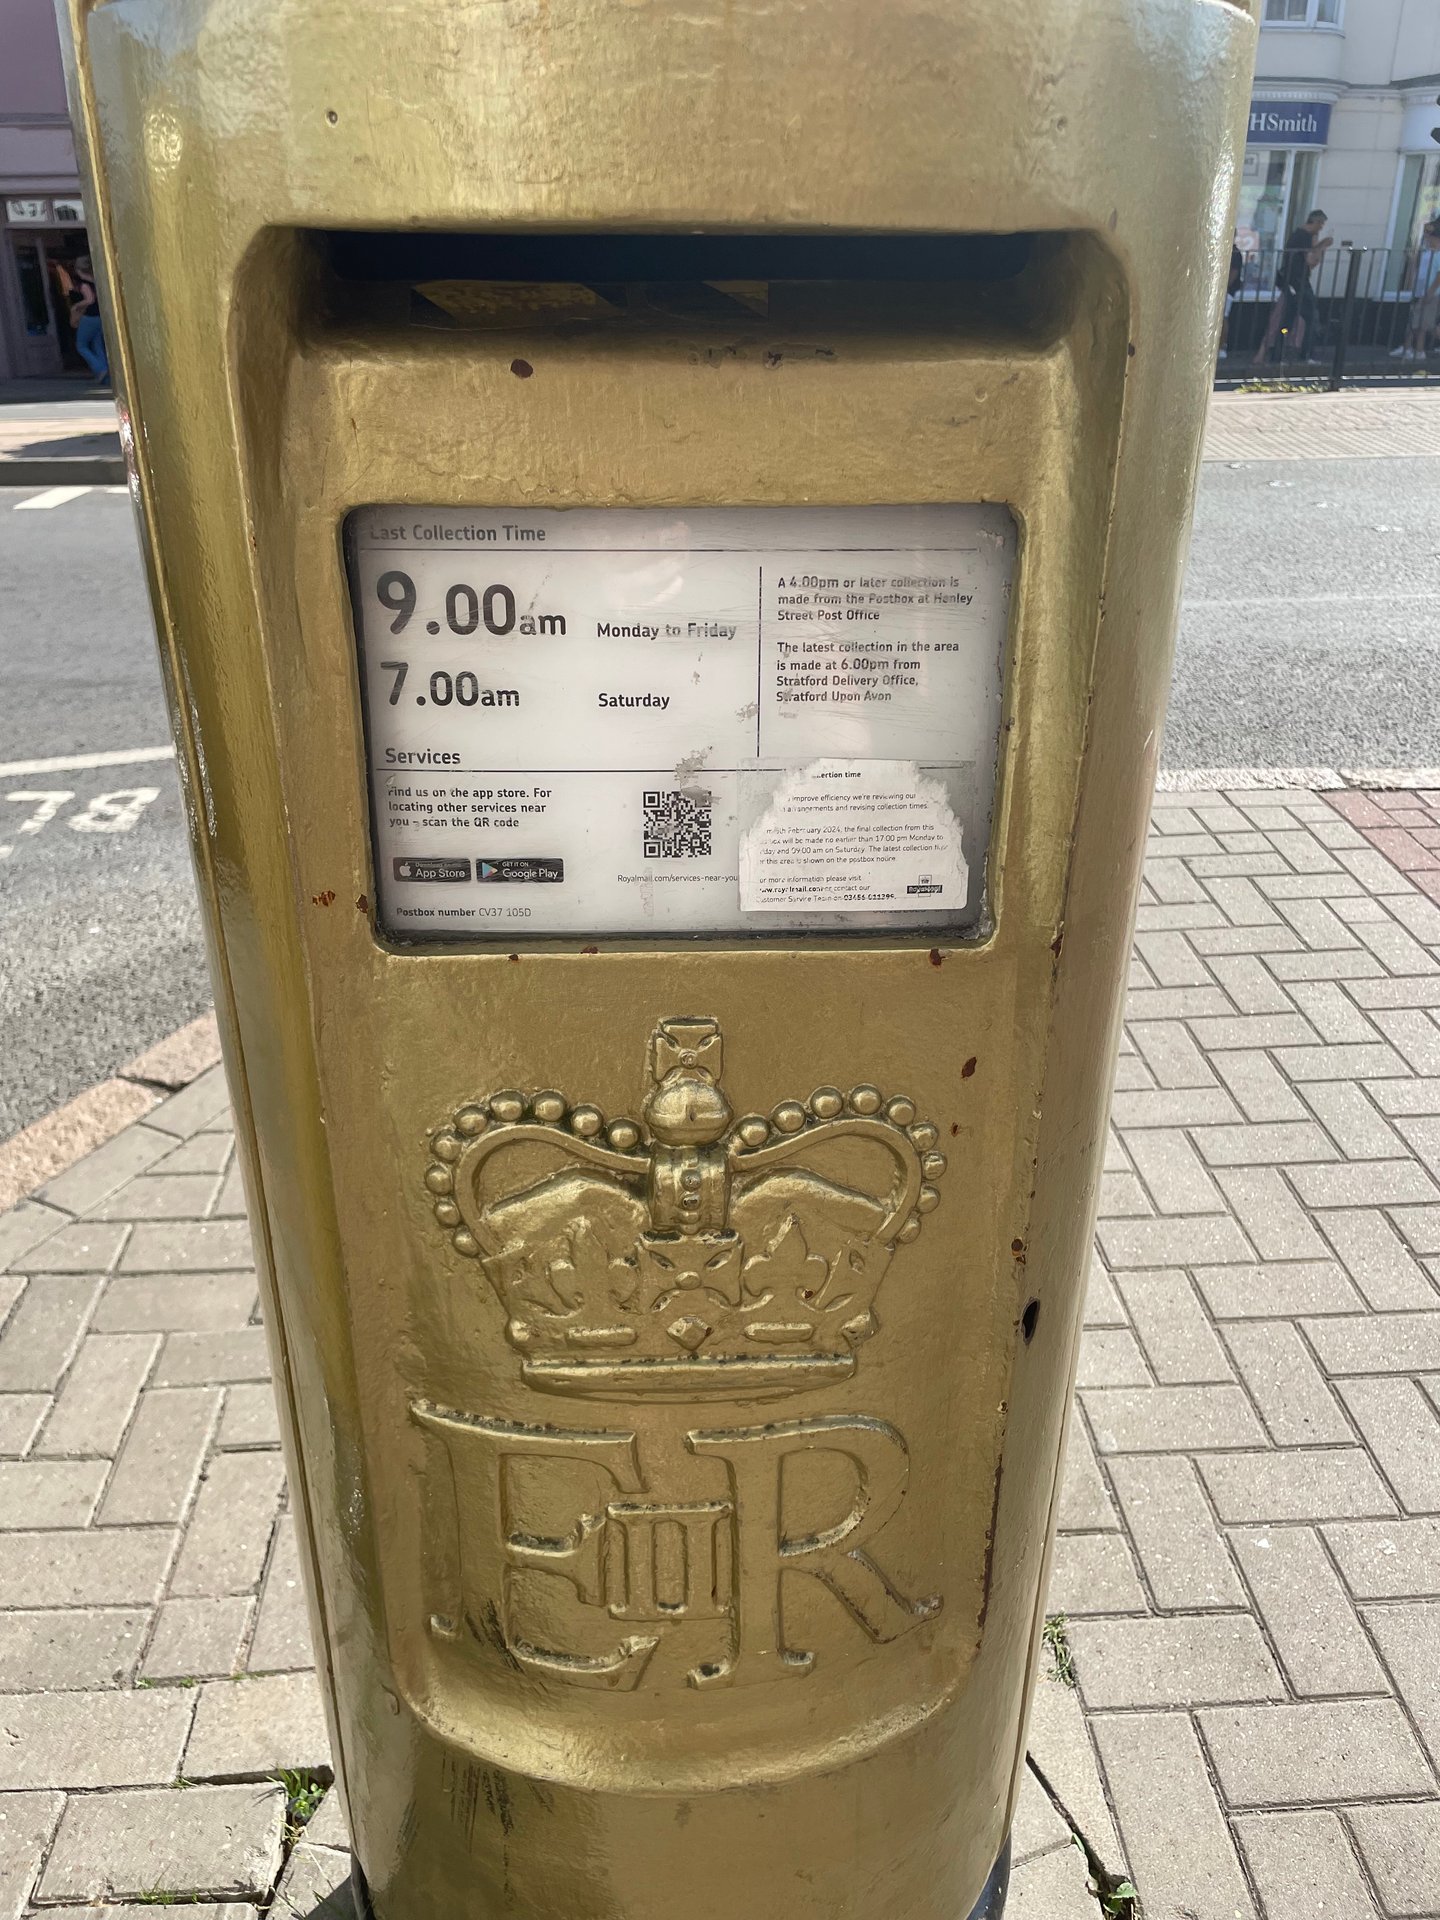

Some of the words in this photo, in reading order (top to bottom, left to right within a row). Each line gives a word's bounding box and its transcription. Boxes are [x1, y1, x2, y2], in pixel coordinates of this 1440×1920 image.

[1250, 112, 1317, 132] HSmith
[370, 525, 407, 541] Last
[413, 524, 497, 541] Collection
[502, 524, 546, 541] Time
[778, 577, 786, 588] A
[789, 575, 839, 590] 4.00pm
[843, 579, 856, 588] or
[860, 577, 887, 588] later
[891, 576, 946, 588] collection
[950, 575, 959, 587] is
[376, 570, 567, 636] 9.00am
[597, 622, 660, 641] Monday
[666, 624, 681, 637] to
[687, 622, 737, 641] Friday
[777, 594, 810, 604] made
[813, 593, 842, 604] from
[846, 594, 864, 604] the
[868, 593, 914, 604] Postbox
[917, 594, 930, 604] at
[934, 592, 973, 606] Henley
[777, 609, 814, 621] Street
[817, 609, 843, 620] Post
[846, 609, 880, 620] Office
[776, 642, 799, 653] The
[802, 642, 835, 653] latest
[838, 641, 893, 652] collection
[896, 641, 908, 652] in
[911, 641, 930, 652] the
[934, 643, 959, 652] area
[776, 659, 786, 671] is
[790, 659, 822, 671] made
[825, 660, 837, 670] at
[840, 658, 889, 672] 6.00pm
[893, 659, 921, 670] from
[380, 661, 520, 707] 7.00am
[598, 692, 670, 710] Saturday
[776, 675, 828, 686] Stratford
[832, 674, 878, 688] Delivery
[882, 674, 919, 686] Office,
[831, 690, 861, 704] Upon
[863, 690, 892, 701] Avon
[385, 747, 461, 766] Services
[415, 789, 429, 797] us
[432, 789, 447, 797] on
[450, 787, 469, 798] the
[472, 789, 494, 800] app
[497, 788, 530, 798] store.
[533, 787, 552, 798] For
[820, 794, 851, 802] efficiency
[388, 801, 433, 814] locating
[437, 802, 468, 812] other
[471, 802, 517, 813] services
[520, 804, 547, 812] near
[389, 818, 410, 828] you
[422, 818, 448, 827] scan
[451, 817, 470, 827] the
[474, 817, 490, 827] QR
[493, 817, 520, 827] code
[415, 868, 437, 880] App
[438, 868, 466, 878] Store
[502, 868, 538, 880] Google
[538, 868, 559, 880] Play
[396, 907, 435, 917] Postbox
[437, 907, 476, 917] number
[478, 907, 503, 917] CV37
